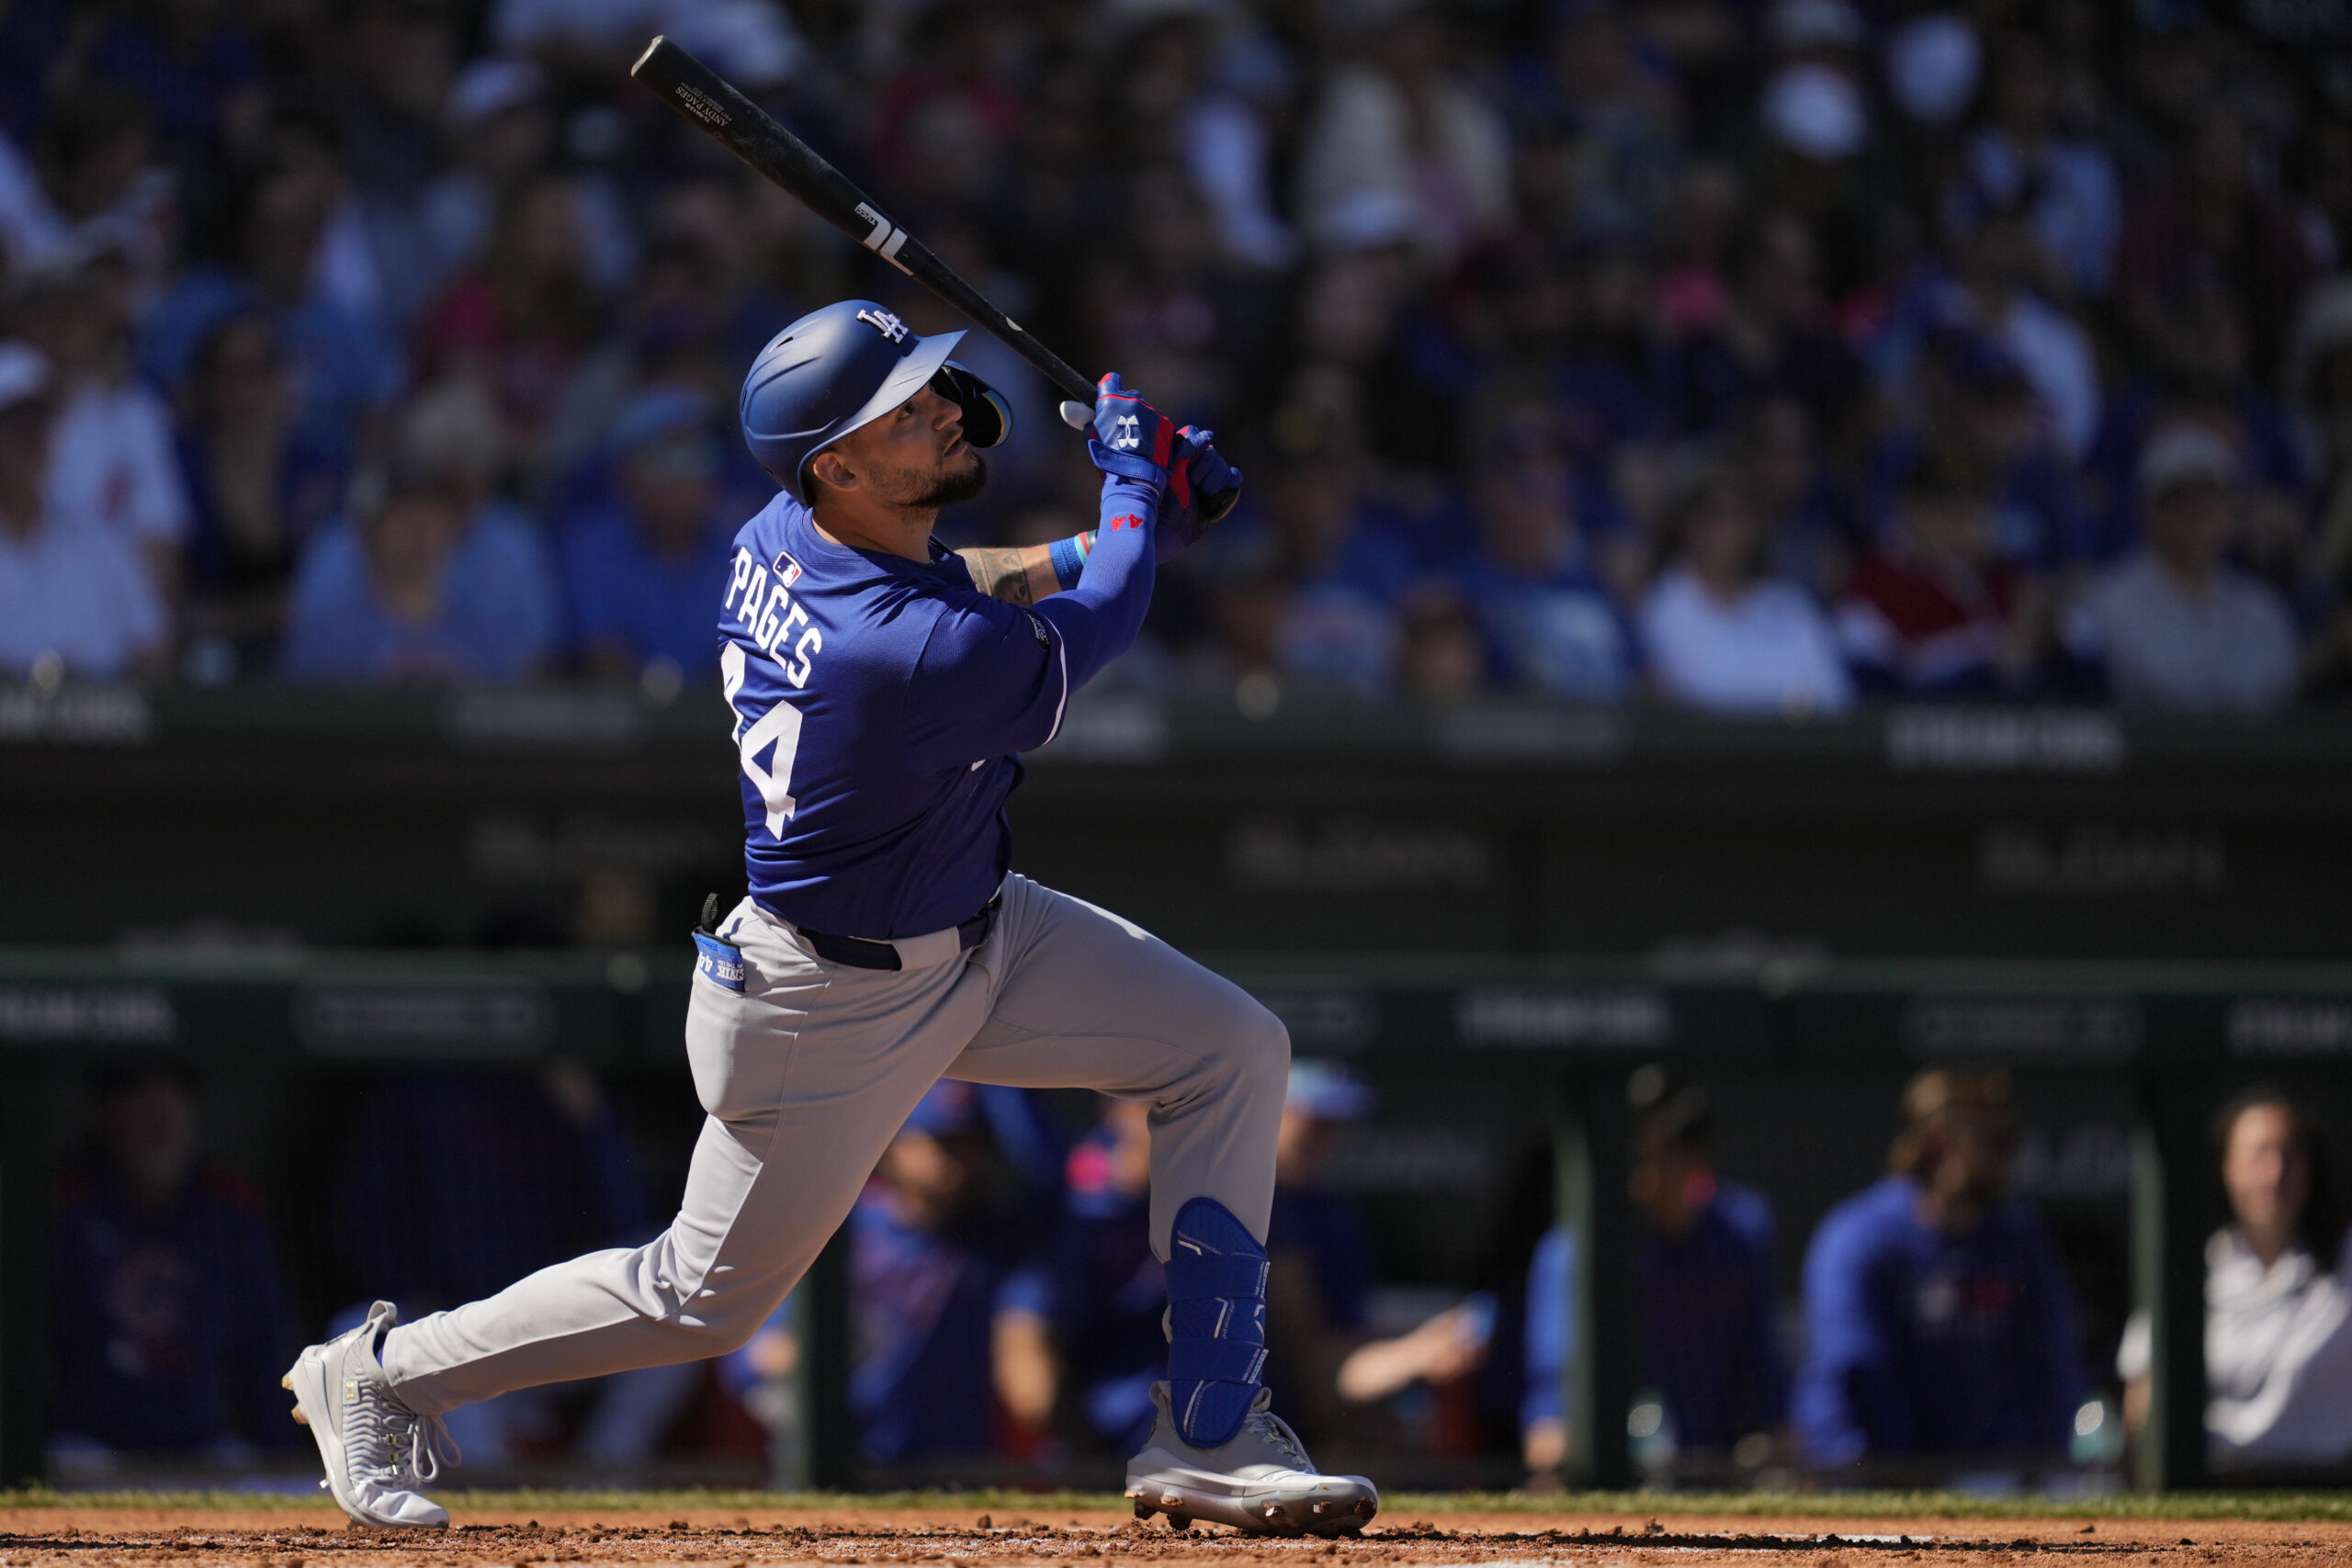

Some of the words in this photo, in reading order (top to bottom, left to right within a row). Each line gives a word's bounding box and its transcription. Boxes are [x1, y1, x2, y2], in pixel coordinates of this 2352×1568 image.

[675, 86, 705, 110] PAGES
[703, 107, 729, 127] ANDY
[854, 206, 876, 226] TUCCI
[856, 309, 909, 344] LA
[1110, 513, 1144, 532] 44
[725, 546, 821, 690] PAGES
